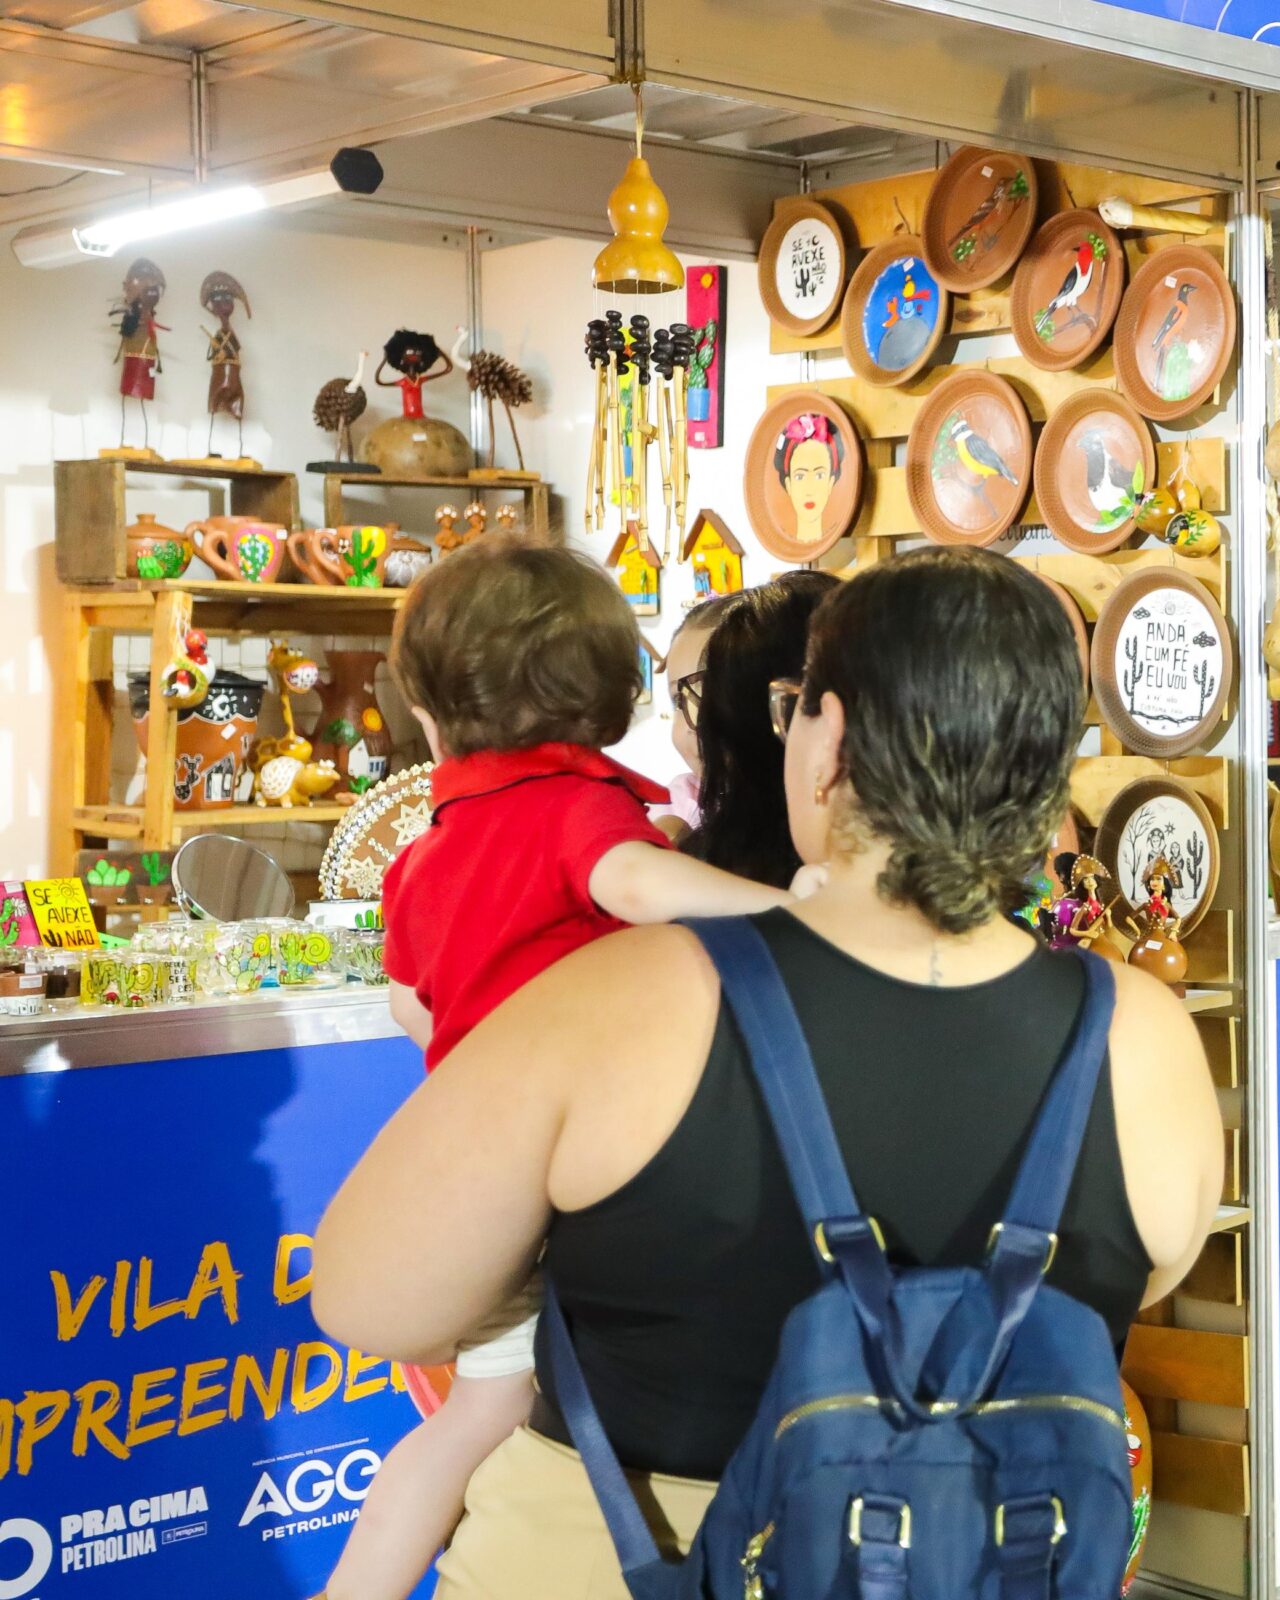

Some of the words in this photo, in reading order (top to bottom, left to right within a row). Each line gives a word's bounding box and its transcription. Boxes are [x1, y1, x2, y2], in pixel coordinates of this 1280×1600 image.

[1146, 665, 1163, 688] EU
[1167, 673, 1187, 690] VOU
[33, 888, 52, 906] SE
[48, 907, 91, 924] AVEXE
[50, 1240, 243, 1342] VILA
[273, 1233, 315, 1306] D
[0, 1341, 408, 1481] PREENDE
[61, 1504, 127, 1543] PRA
[129, 1486, 209, 1527] CIMA
[262, 1507, 361, 1541] PETROLINA
[62, 1527, 157, 1574] PETROLINA
